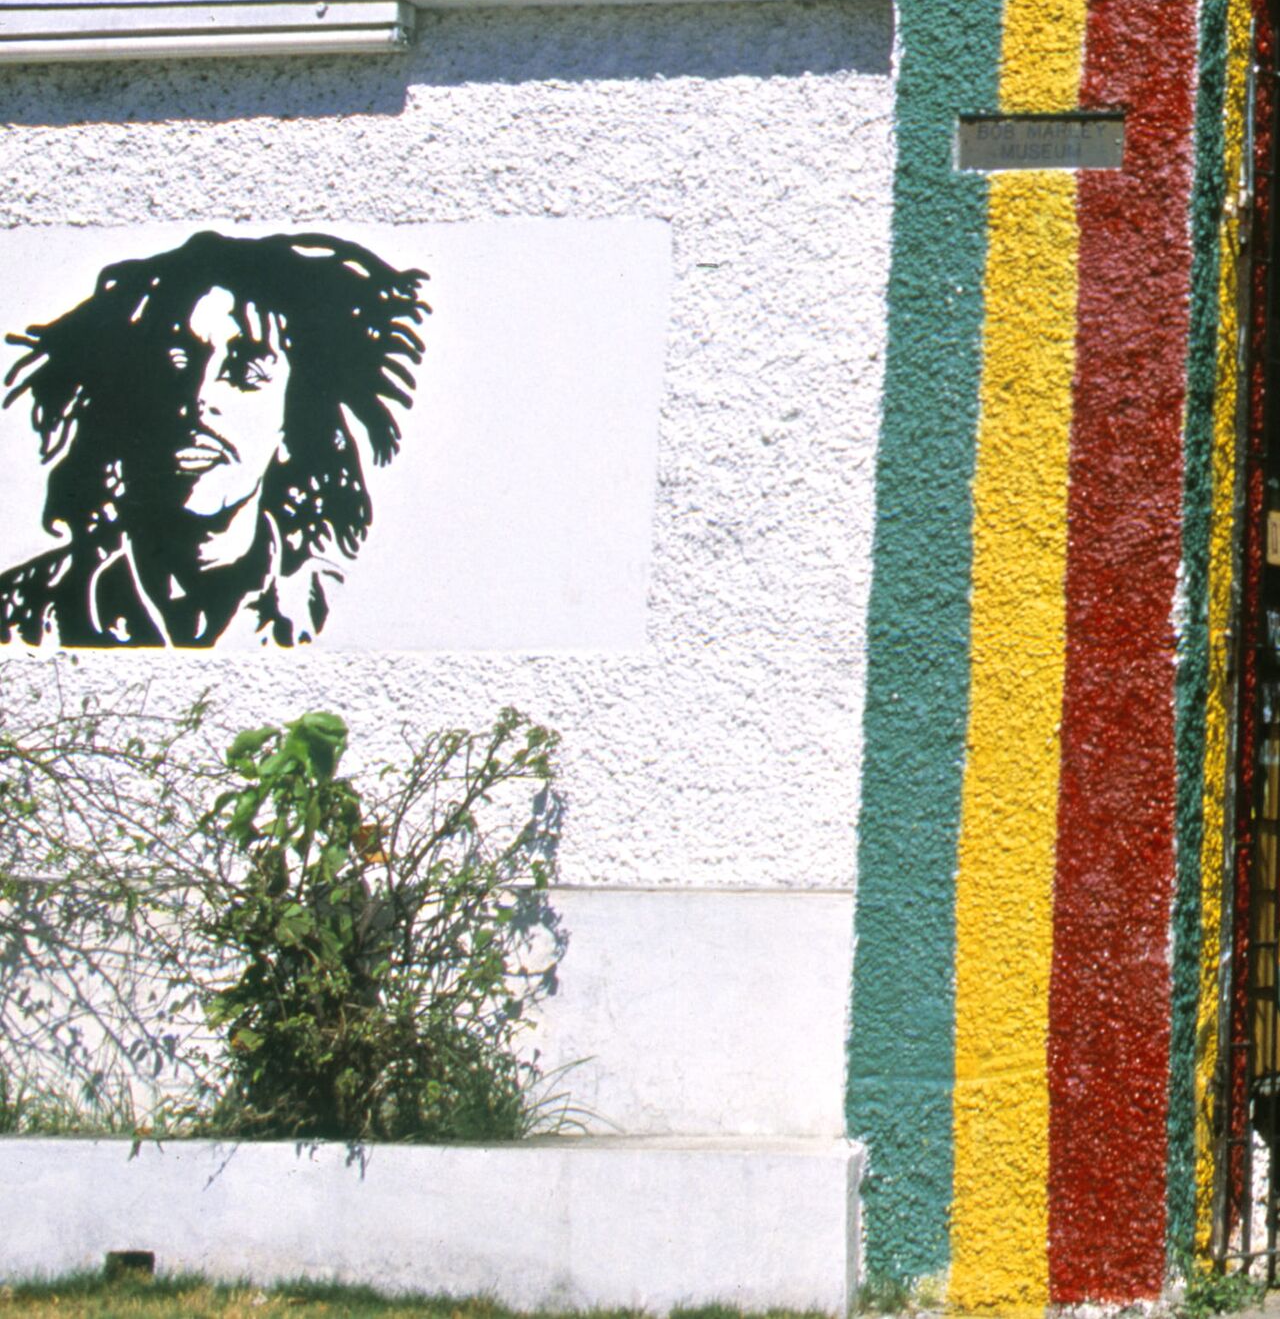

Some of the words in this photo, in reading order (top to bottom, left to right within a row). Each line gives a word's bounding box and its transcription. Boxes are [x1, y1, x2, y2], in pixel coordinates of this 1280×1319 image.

[976, 124, 1016, 140] BOB
[1026, 124, 1108, 139] MARLEY
[1001, 143, 1082, 160] MUSEUM
